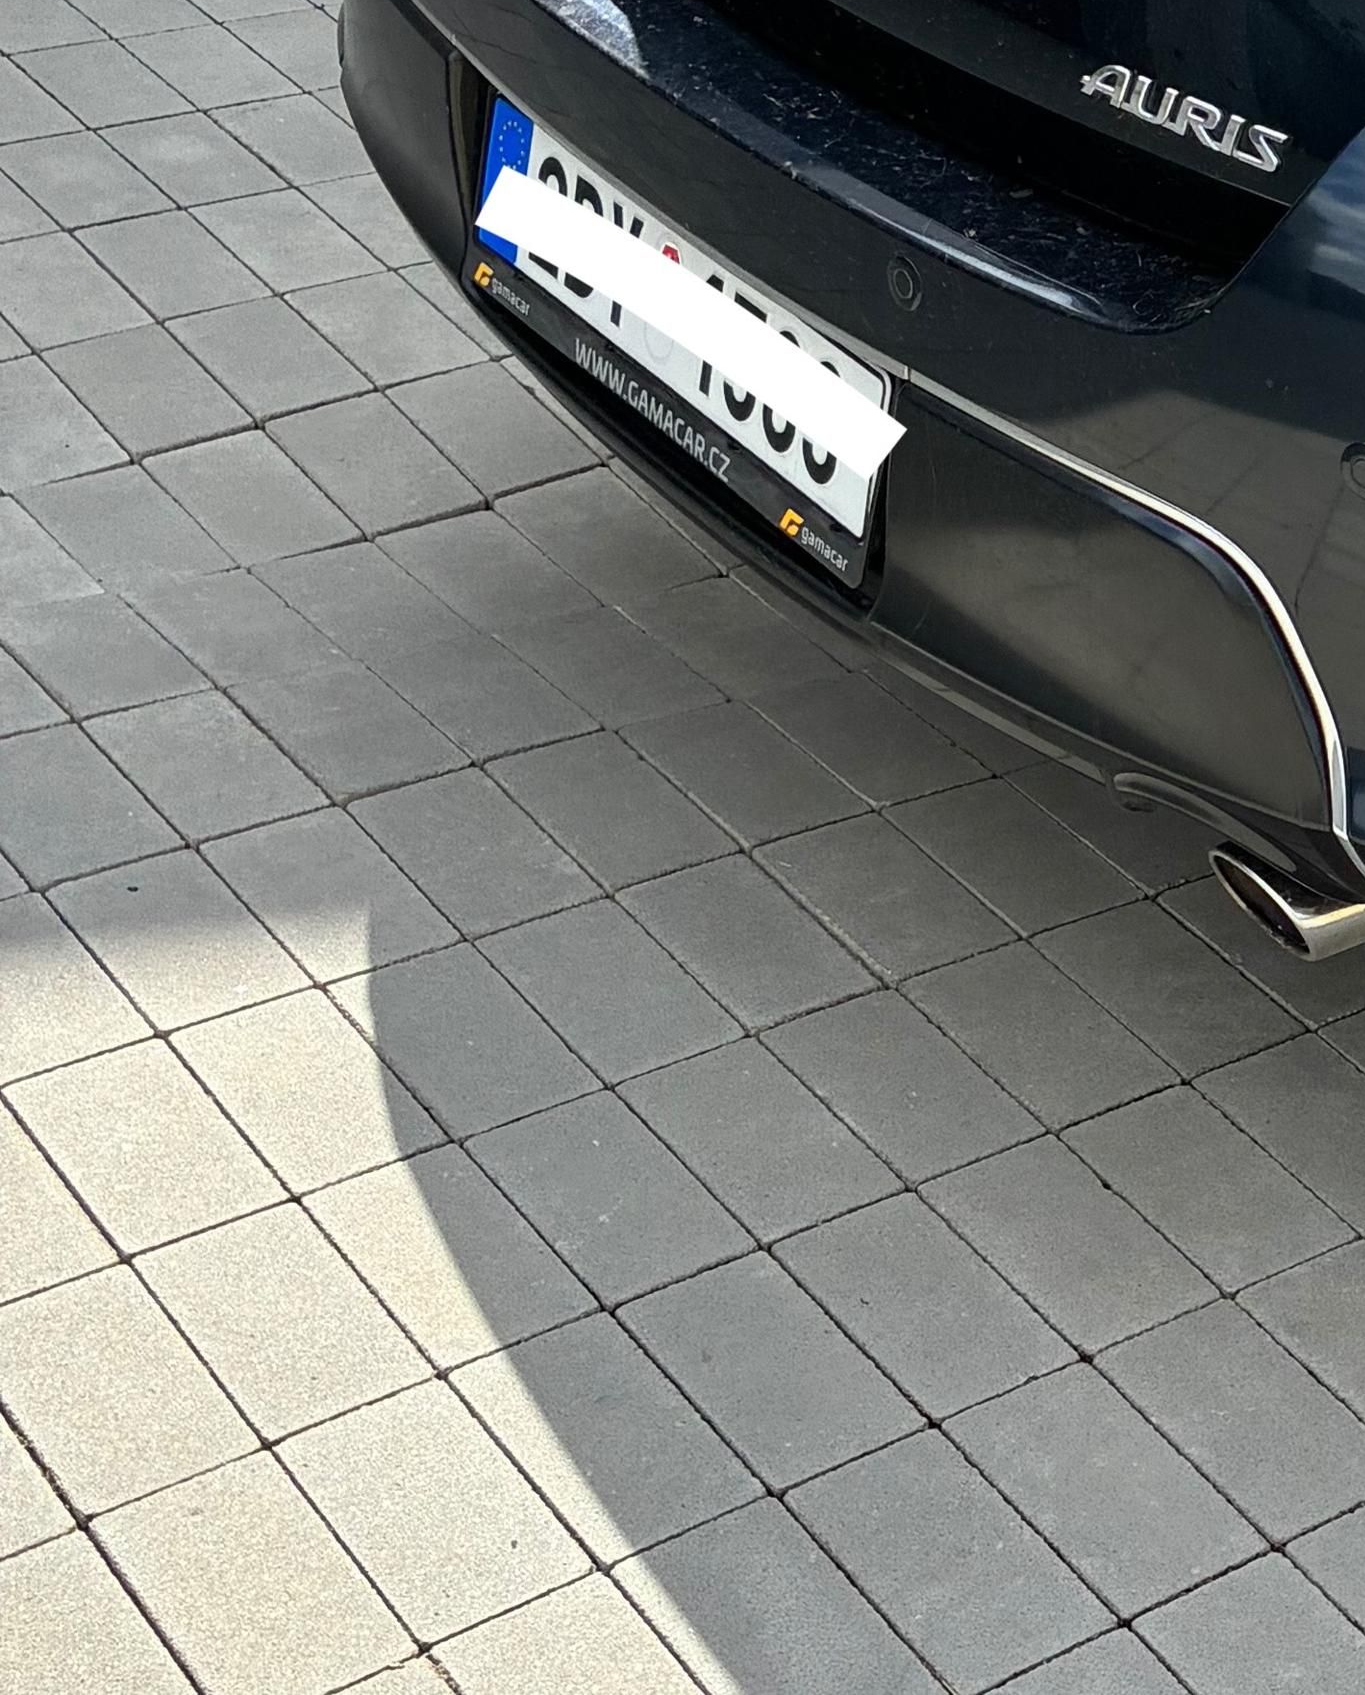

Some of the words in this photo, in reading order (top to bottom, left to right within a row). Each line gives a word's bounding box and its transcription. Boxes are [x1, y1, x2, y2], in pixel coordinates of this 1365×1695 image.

[1079, 64, 1289, 173] AURIS
[491, 277, 530, 316] gamacar
[575, 337, 731, 483] WWW.GAMACAR.CZ
[801, 526, 849, 572] gamacar
